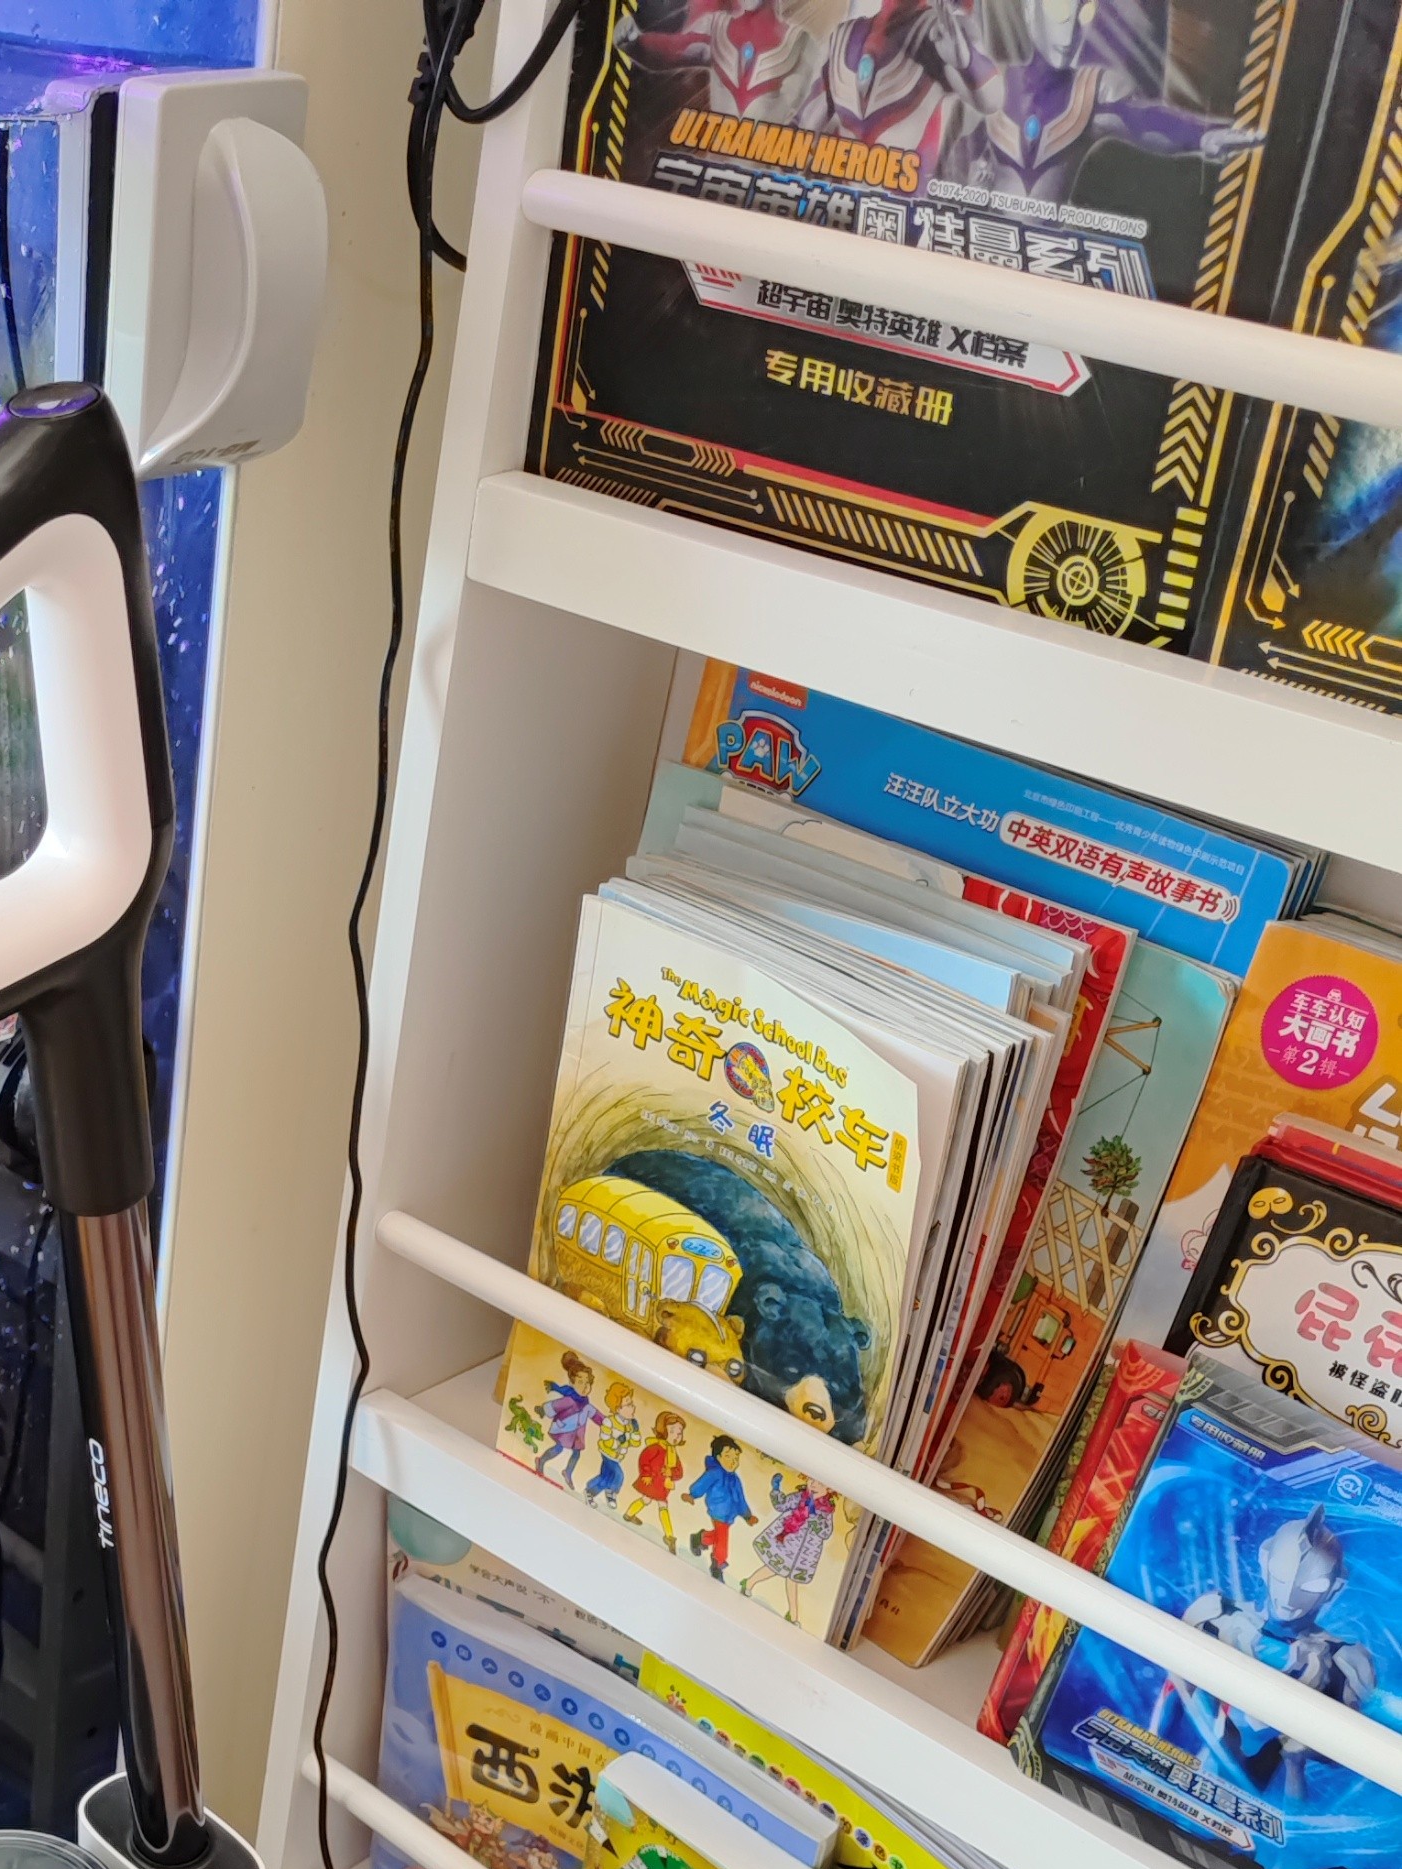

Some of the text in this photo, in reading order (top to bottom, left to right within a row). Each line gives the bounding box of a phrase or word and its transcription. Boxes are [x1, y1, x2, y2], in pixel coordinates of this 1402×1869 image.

[668, 108, 921, 194] ULTRAMAN HEROES
[991, 193, 1057, 221] TSUBURAYA
[1059, 206, 1148, 238] PRODUCTIONS
[835, 298, 943, 348] 奥特英雄
[764, 348, 955, 427] 专用收藏册
[715, 719, 822, 797] PAW
[883, 771, 1002, 834] 汪汪队立大功
[1007, 818, 1224, 915] 中英双语有声故事书
[660, 966, 850, 1090] The Magic School Bus
[1277, 1012, 1361, 1059] 大画书
[1290, 992, 1367, 1031] 车车认知
[604, 976, 890, 1173] 神奇校车
[1280, 1045, 1339, 1080] 第2辑
[707, 1099, 776, 1160] 冬眠
